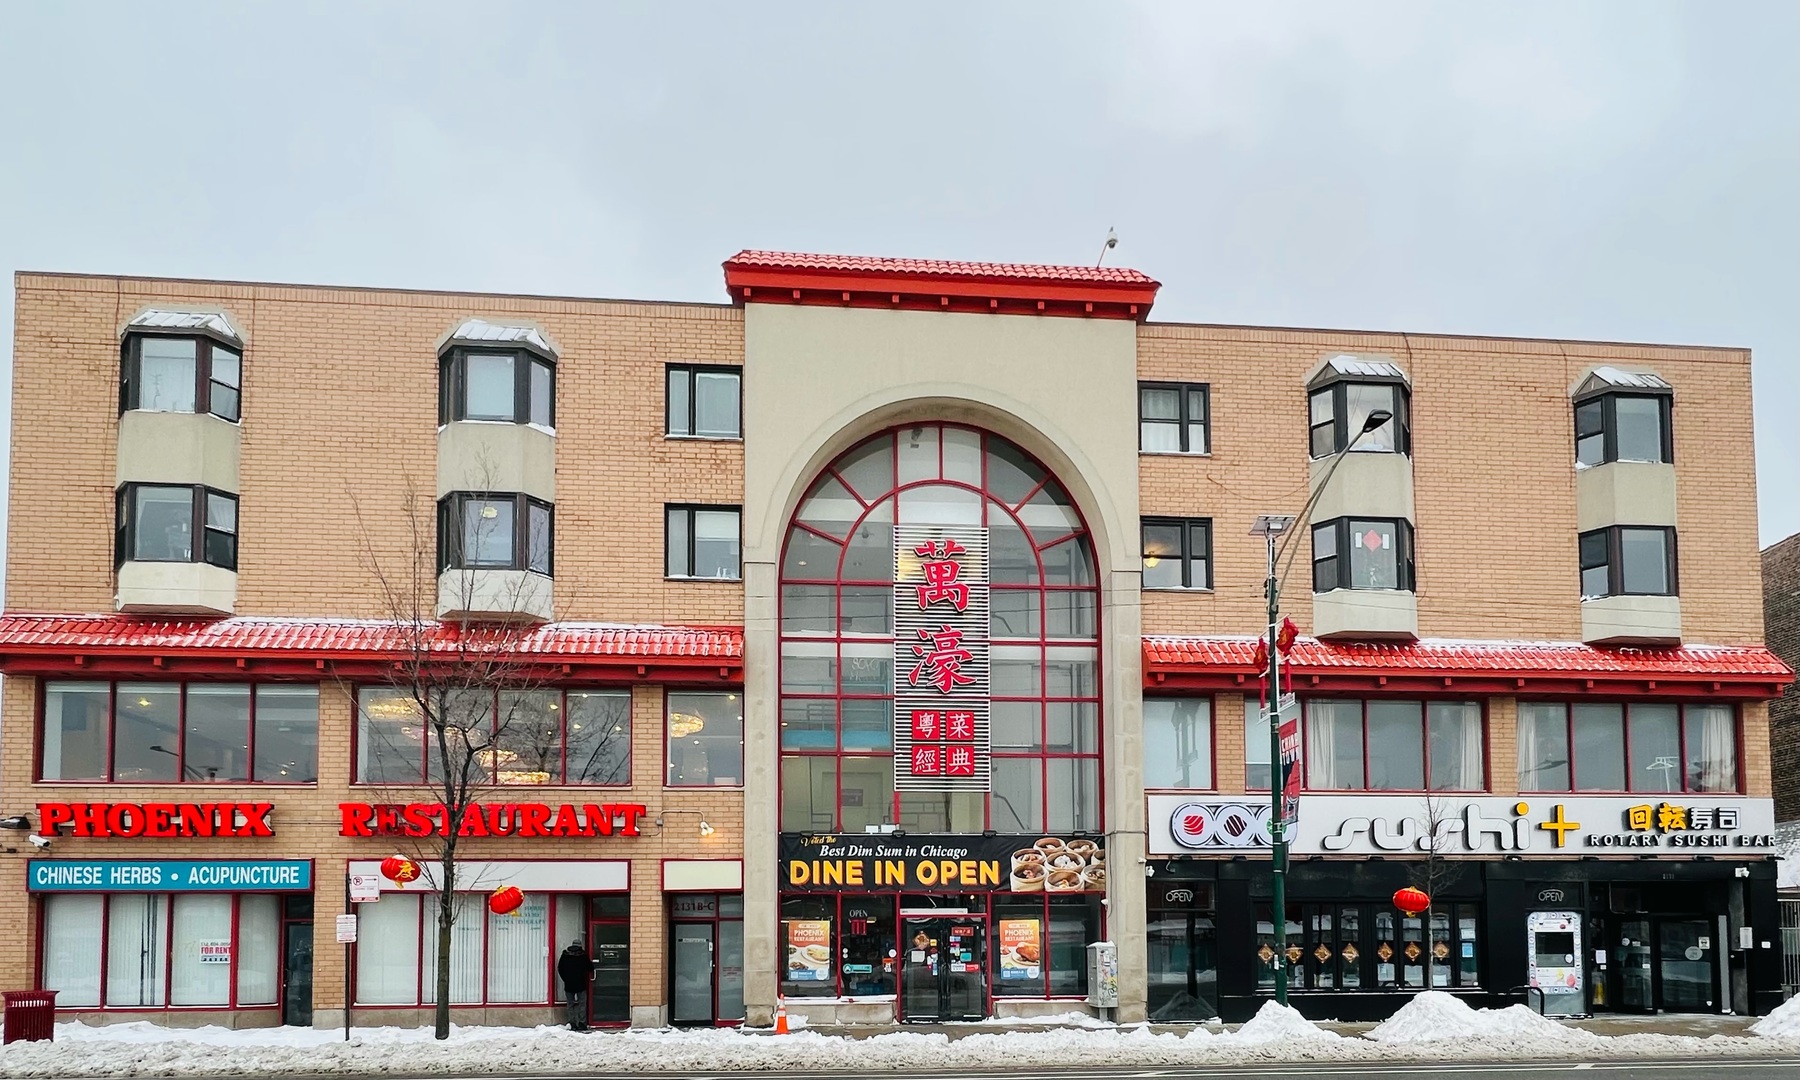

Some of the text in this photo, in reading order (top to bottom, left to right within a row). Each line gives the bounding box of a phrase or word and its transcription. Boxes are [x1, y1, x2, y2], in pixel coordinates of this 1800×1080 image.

[908, 540, 977, 693] 萬濠
[915, 748, 971, 773] 經典
[36, 803, 647, 837] PHOENIX RESTAURANT
[1628, 802, 1742, 833] 回転寿司
[801, 836, 837, 846] Voted the
[1590, 834, 1777, 846] ROTARY SUSHI BAR
[819, 845, 968, 859] Best Dim Sum in Chicago
[36, 866, 300, 884] CHINESE HERBS ACUPUNCTURE
[790, 860, 1000, 886] DINE IN OPEN
[1165, 890, 1193, 902] OPEN
[1538, 890, 1564, 902] OPEN
[849, 909, 868, 918] OPEN
[201, 946, 214, 954] FOR
